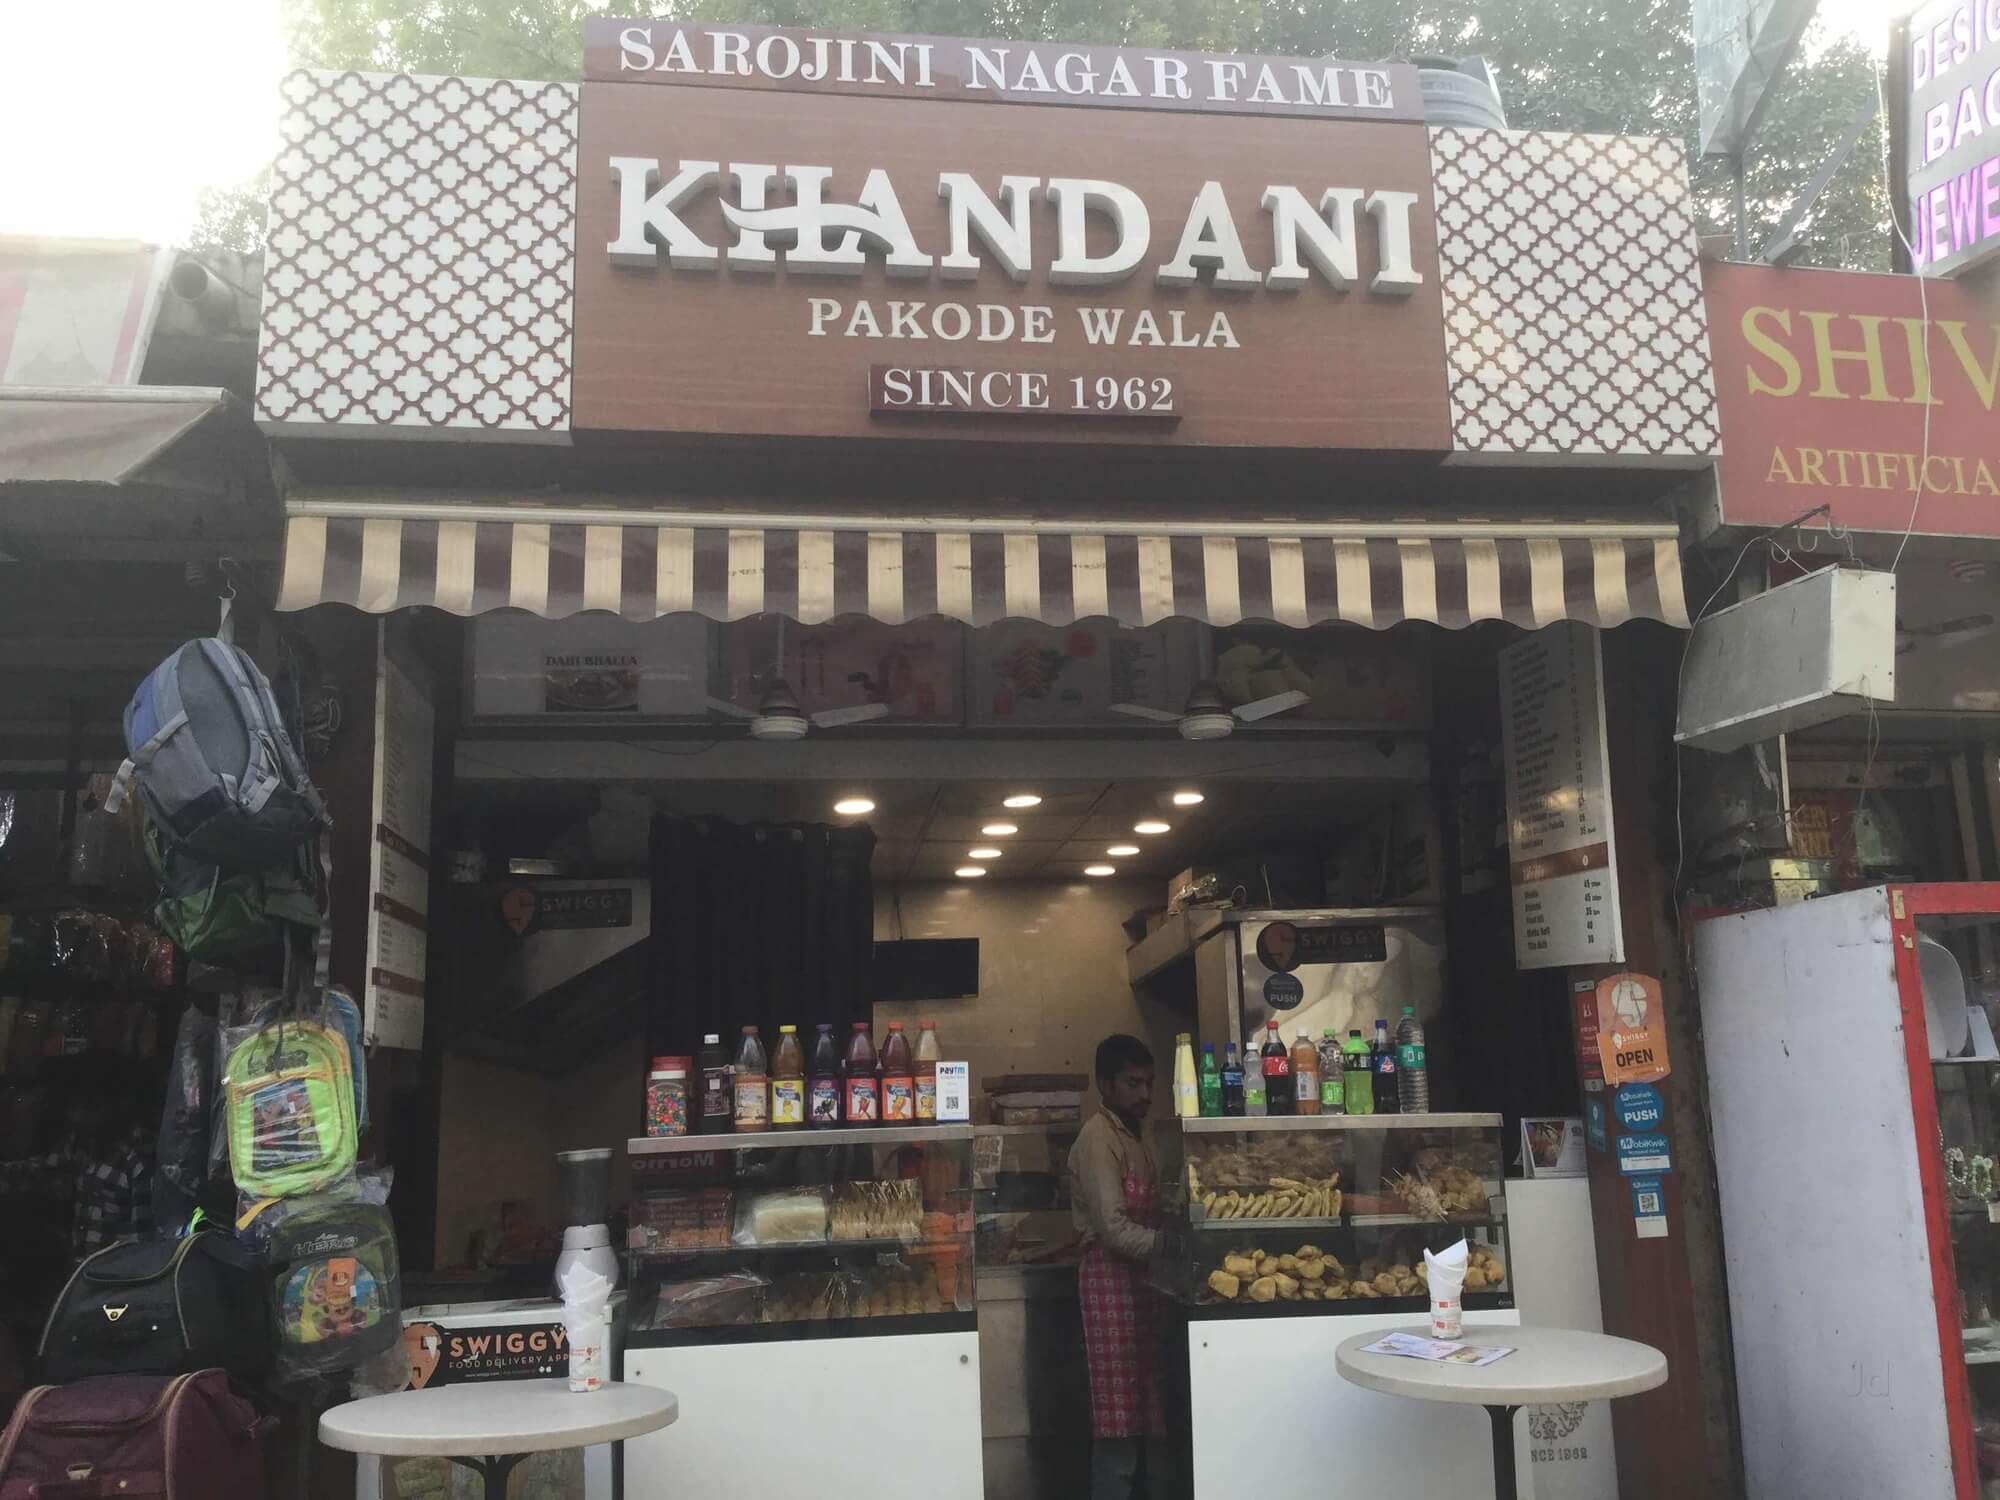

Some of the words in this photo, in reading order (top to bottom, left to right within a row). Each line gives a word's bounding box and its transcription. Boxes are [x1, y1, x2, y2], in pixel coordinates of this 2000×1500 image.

[619, 26, 936, 89] SAROJINI
[963, 46, 1193, 103] NAGAR
[1206, 60, 1394, 110] FAME
[605, 155, 1424, 295] KHANDANI
[807, 297, 1057, 344] PAKODE
[1077, 307, 1241, 349] WALA
[1741, 306, 2000, 411] SHIV
[882, 369, 1051, 410] SINCE
[1069, 376, 1175, 411] 1962
[1766, 445, 2000, 496] ARTIFICIA
[542, 894, 622, 913] SWIGG
[1301, 928, 1382, 950] SWIGGY
[1270, 992, 1297, 1003] PUSH
[1615, 1048, 1654, 1068] OPEN
[1623, 1108, 1658, 1123] PUSH
[449, 1329, 567, 1358] SWIGGY
[449, 1355, 481, 1369] FOOD
[486, 1353, 542, 1369] DELIVERY
[1531, 1448, 1555, 1462] NCE
